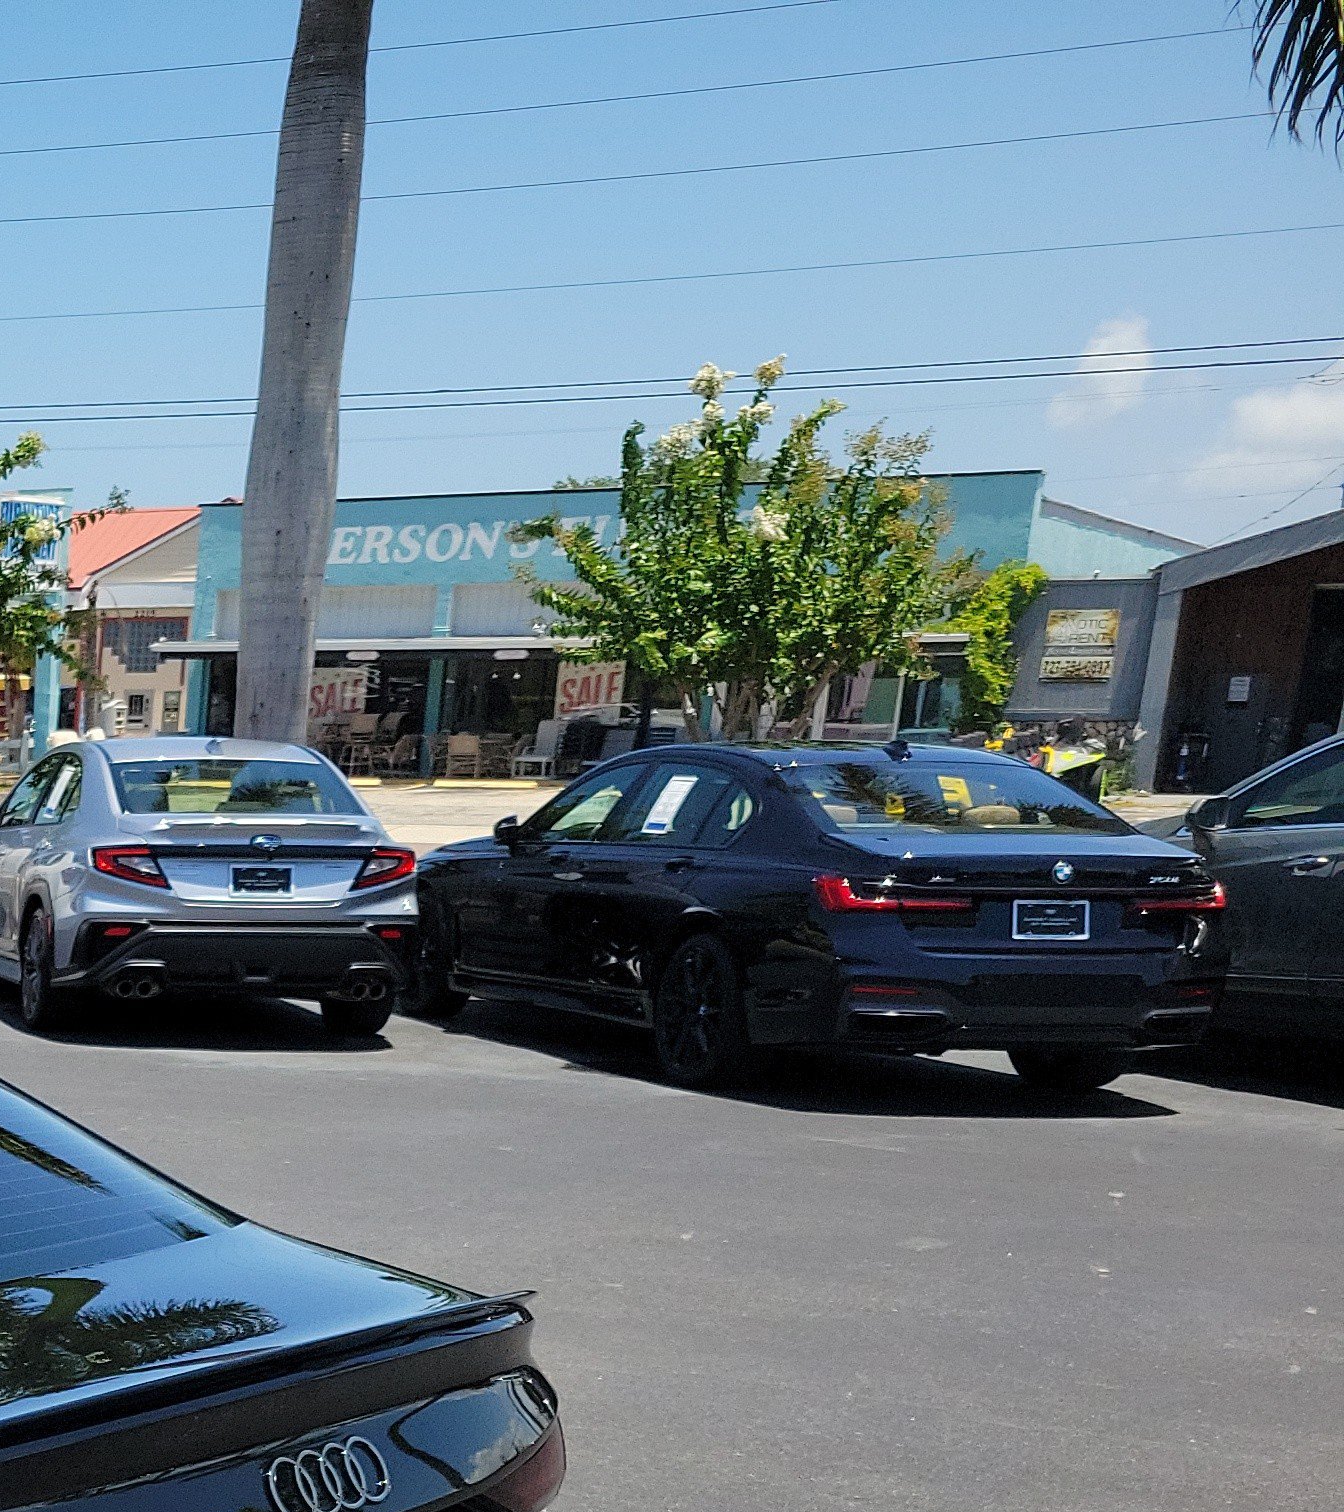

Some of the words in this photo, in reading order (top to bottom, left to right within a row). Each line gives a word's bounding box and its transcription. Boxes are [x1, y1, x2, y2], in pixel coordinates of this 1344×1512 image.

[1060, 619, 1110, 630] OTIC
[308, 678, 364, 718] SALE
[558, 671, 621, 713] SALE
